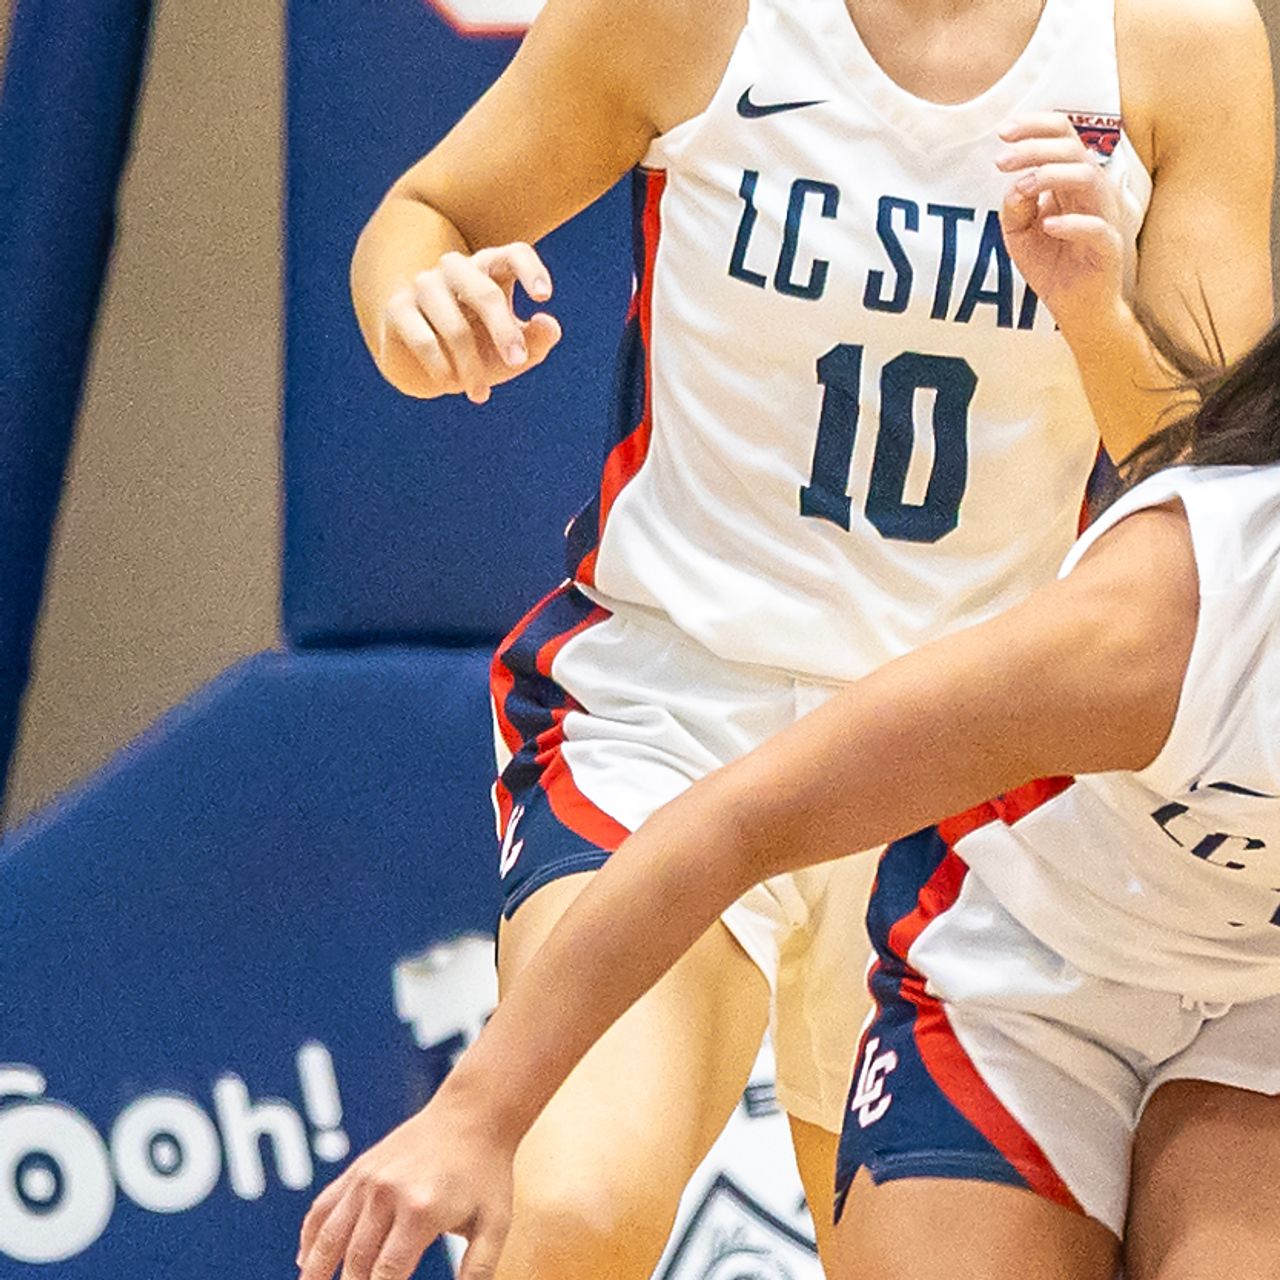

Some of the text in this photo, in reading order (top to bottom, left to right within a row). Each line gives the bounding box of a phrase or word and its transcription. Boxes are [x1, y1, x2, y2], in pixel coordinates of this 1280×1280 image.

[727, 169, 1062, 332] LC STA
[800, 342, 979, 544] 10
